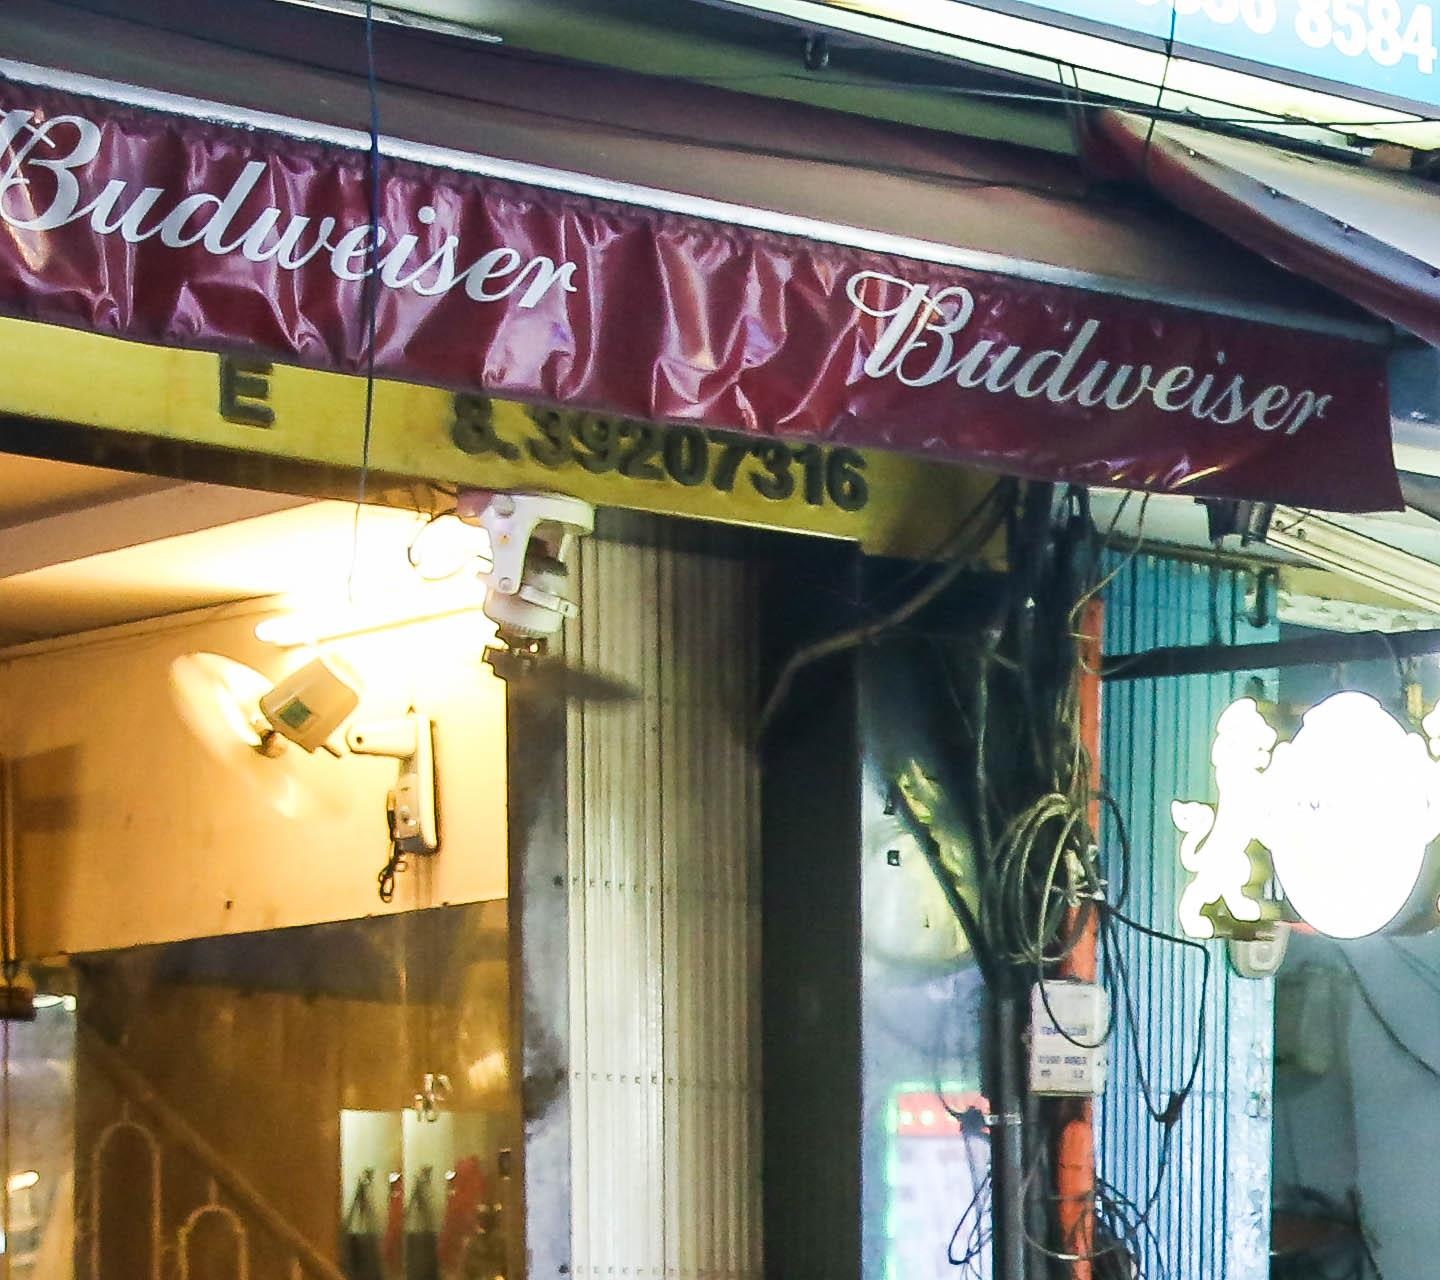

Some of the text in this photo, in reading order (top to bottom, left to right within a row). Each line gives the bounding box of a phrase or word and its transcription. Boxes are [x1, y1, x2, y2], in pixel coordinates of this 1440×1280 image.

[1295, 0, 1437, 74] 8584
[0, 109, 578, 310] Budweiser
[845, 270, 1332, 436] Budweiser
